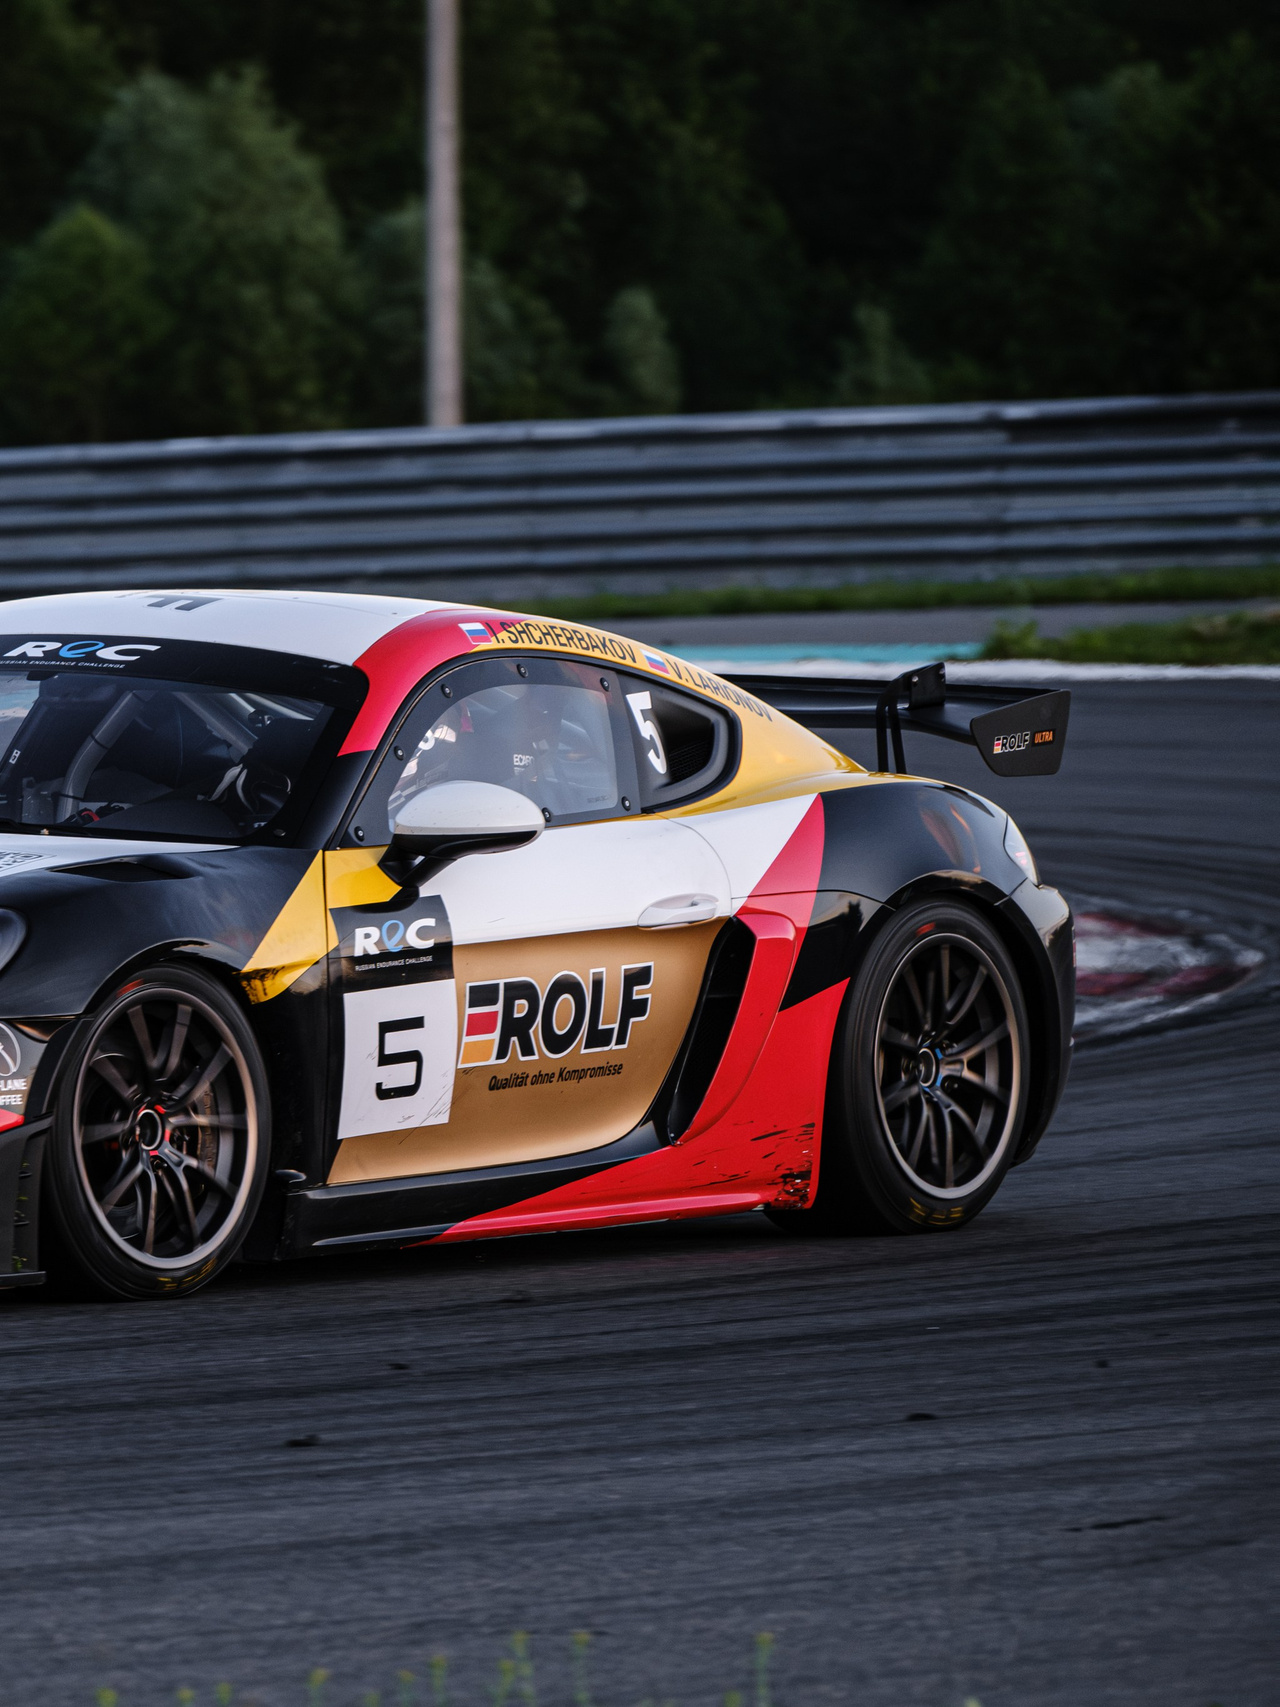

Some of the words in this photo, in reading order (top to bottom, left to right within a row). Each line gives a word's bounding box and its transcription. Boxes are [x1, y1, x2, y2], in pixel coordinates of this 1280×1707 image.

[484, 622, 501, 644] I.
[500, 621, 637, 664] SHCHERBAKOV
[78, 661, 126, 669] CHALLENGE
[666, 658, 690, 683] V.
[690, 669, 773, 722] LARIONOV
[626, 691, 667, 775] 5
[1000, 731, 1031, 753] ROLF
[1034, 730, 1053, 744] ULTRA
[355, 963, 376, 971] RUSSIAN
[376, 958, 405, 969] ENDURANCE
[405, 955, 433, 965] CHALLENGE
[495, 961, 655, 1063] ROLF
[375, 1015, 425, 1100] 5
[488, 1072, 529, 1091] Qualität
[530, 1070, 556, 1086] ohne
[556, 1061, 623, 1084] Kompromisse
